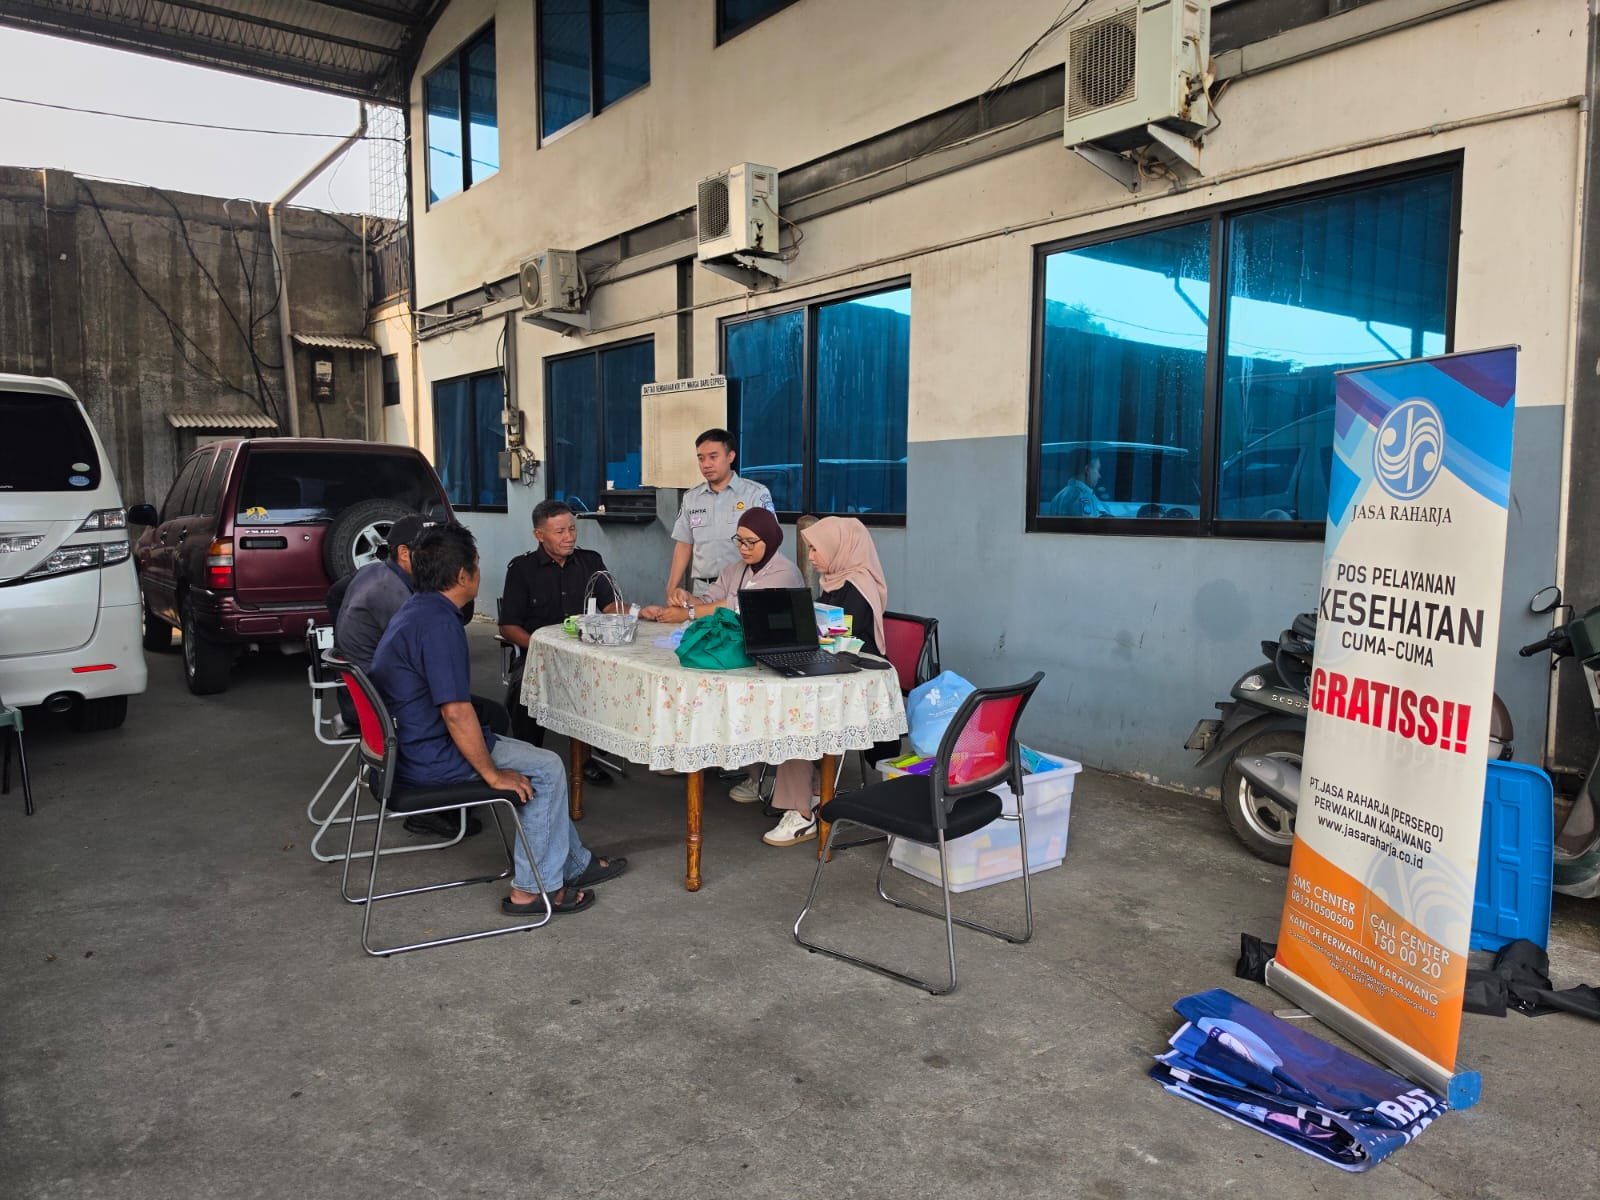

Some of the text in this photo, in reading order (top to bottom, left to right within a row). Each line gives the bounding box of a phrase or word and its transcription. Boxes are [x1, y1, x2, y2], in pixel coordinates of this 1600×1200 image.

[1351, 504, 1452, 527] JASA RAHARJA
[1337, 564, 1456, 596] POS PELAYANAN
[1319, 587, 1485, 648] KESEHATAN
[1341, 631, 1434, 668] CUMA-CUMA
[1311, 668, 1472, 755] GRATISS!!
[1314, 795, 1432, 854] PERWAKILAN KARAWANG
[1346, 790, 1390, 815] RAHARJA
[1317, 815, 1424, 870] www.jasaraharja.co.id
[1291, 891, 1355, 930] 081210500500
[1293, 873, 1356, 915] SMS CENTER
[1288, 913, 1321, 939] KANTOR
[1322, 928, 1377, 970] PERWAKILAN
[1379, 963, 1440, 1006] KARAWANG
[1370, 914, 1450, 965] CALL CENTER
[1373, 930, 1442, 979] 150 00 20
[1376, 1088, 1437, 1128] RAT
